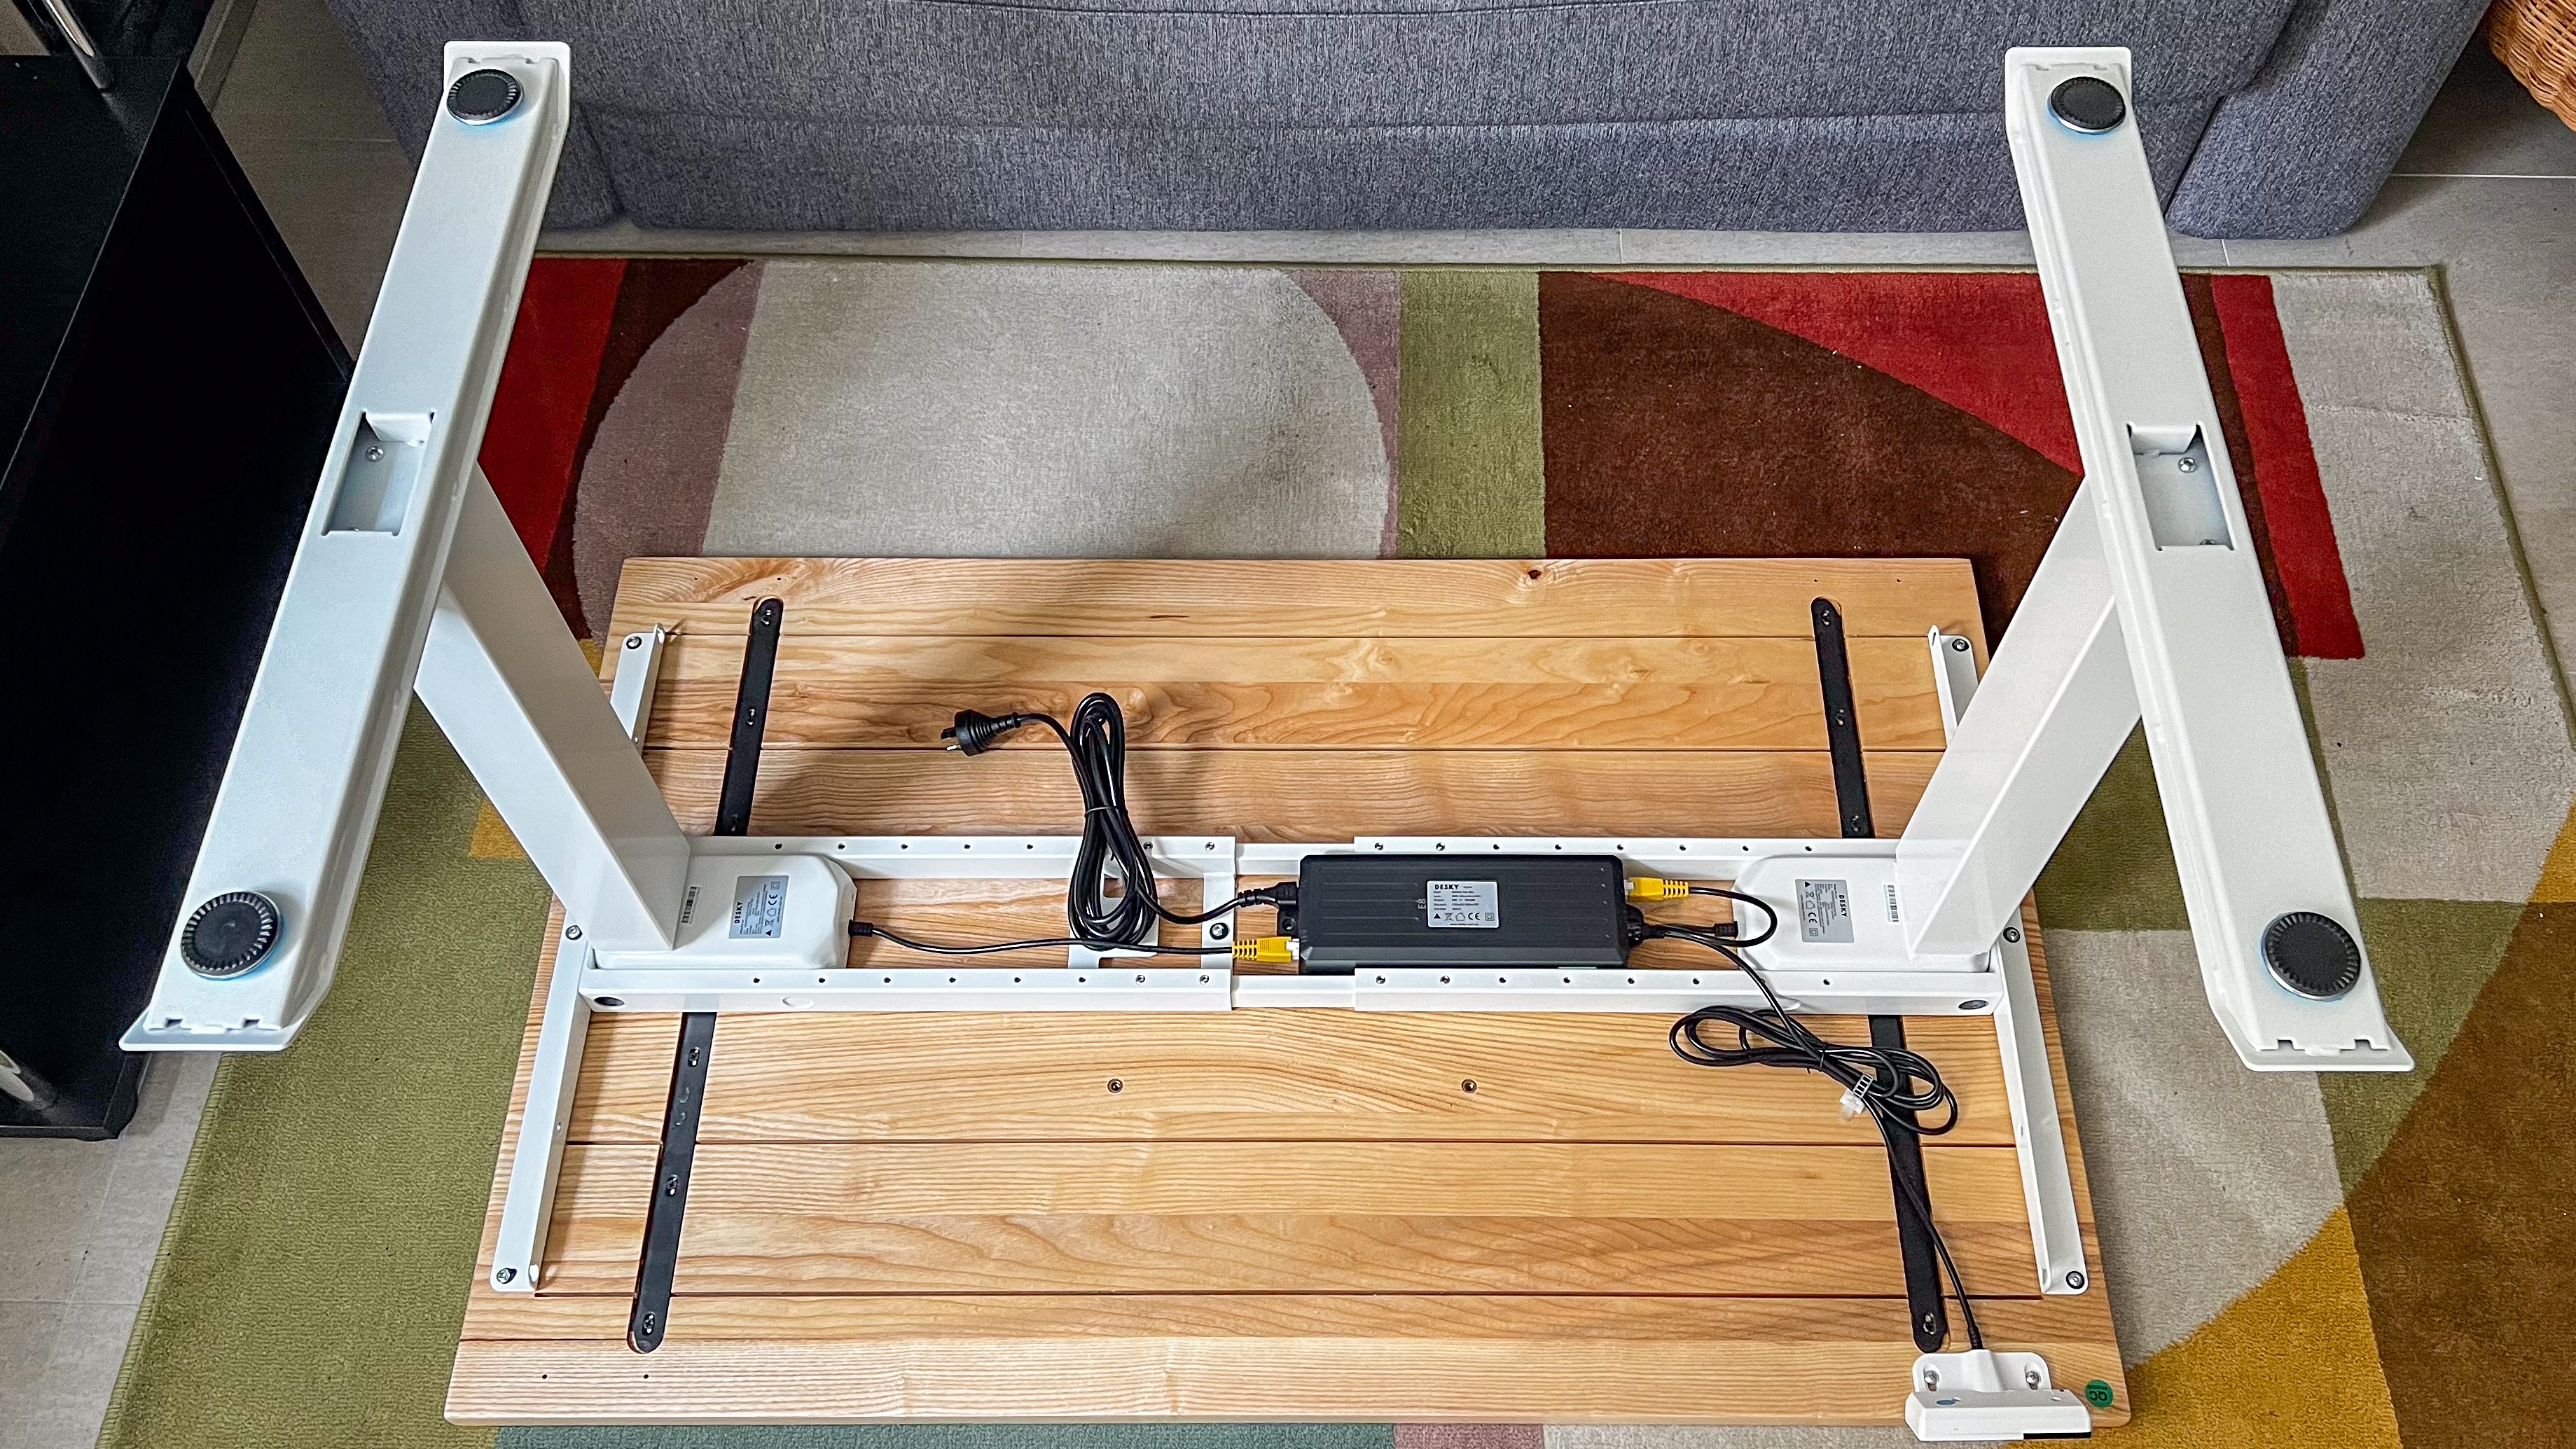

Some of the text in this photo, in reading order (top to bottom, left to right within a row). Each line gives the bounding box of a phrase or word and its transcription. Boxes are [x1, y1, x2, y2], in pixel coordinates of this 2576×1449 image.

[1418, 898, 1427, 909] E8
[1838, 894, 1848, 917] DESKY
[734, 901, 743, 924] DESKY
[2089, 1390, 2107, 1401] QC
